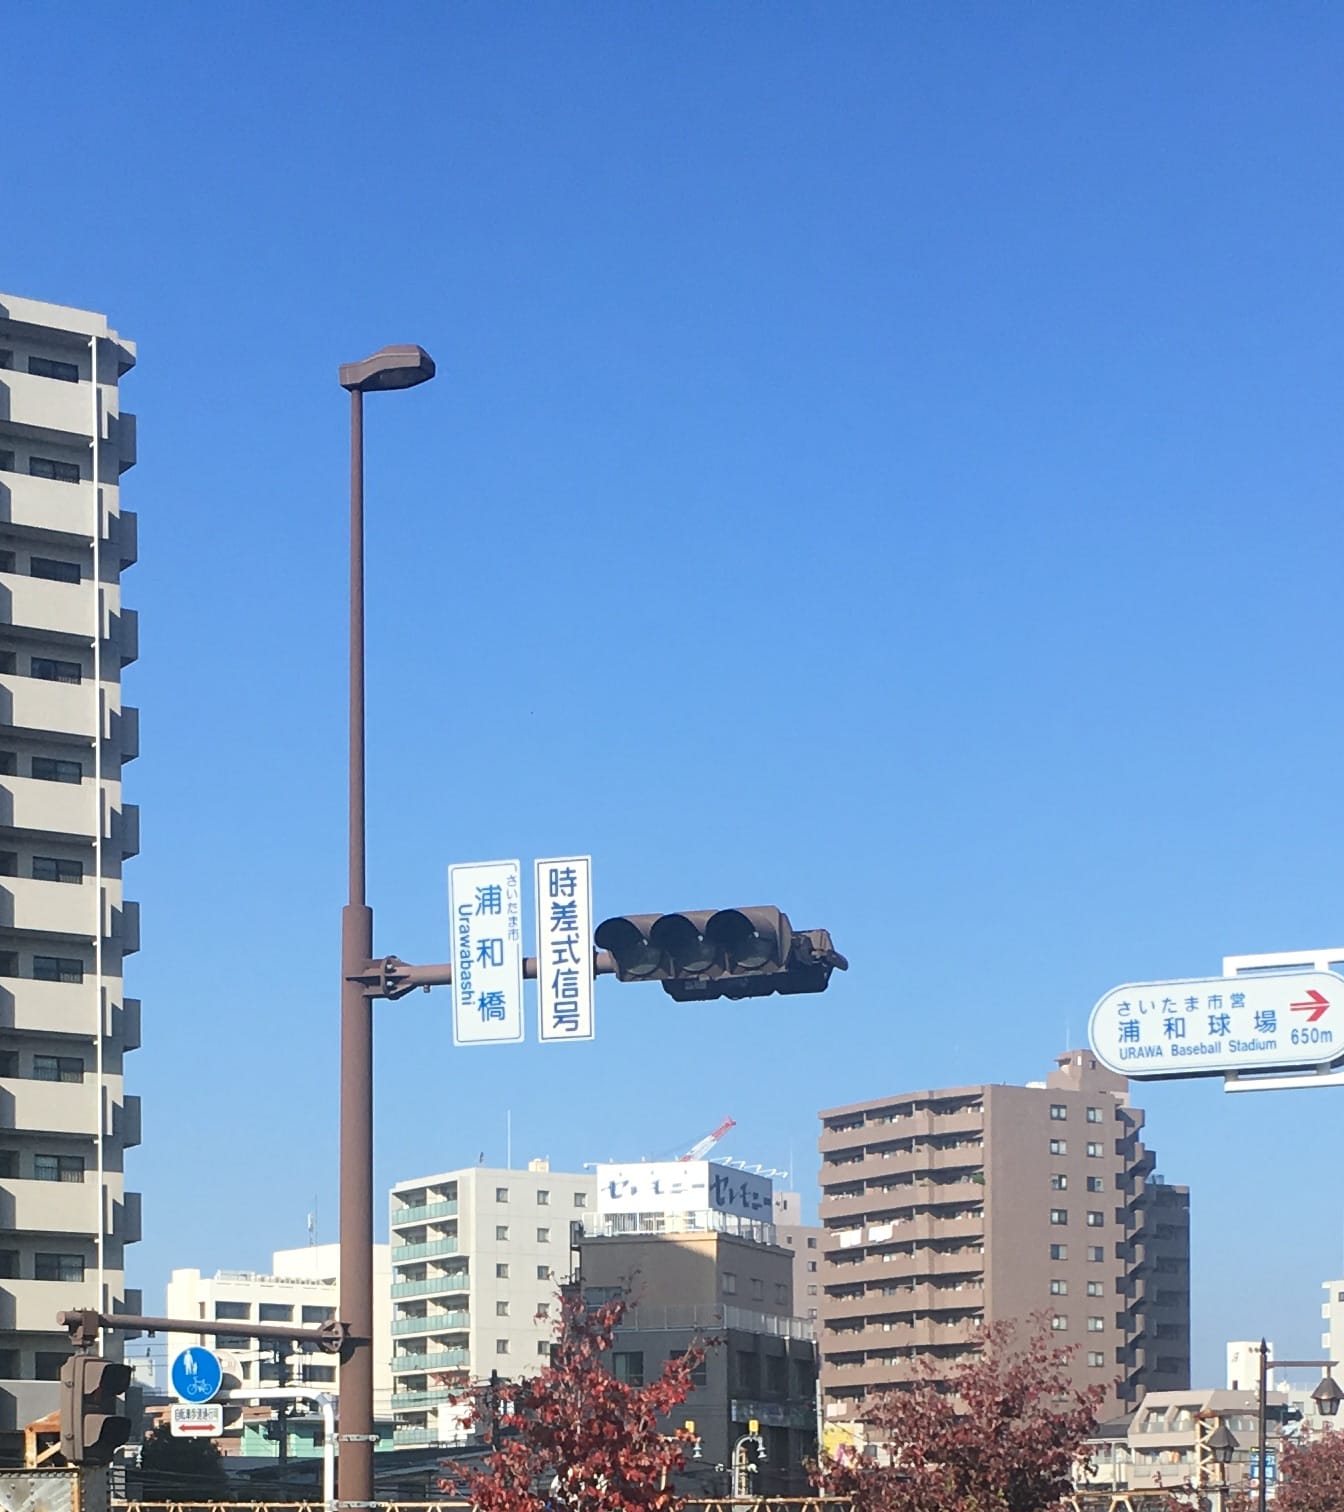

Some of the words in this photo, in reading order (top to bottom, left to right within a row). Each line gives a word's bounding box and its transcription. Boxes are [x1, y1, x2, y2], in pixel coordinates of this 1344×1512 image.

[506, 874, 519, 941] さいたま市
[458, 904, 475, 1006] Urawabashi
[474, 884, 506, 1022] 浦和橋
[549, 867, 580, 1032] 時差式信号
[1116, 992, 1247, 1017] さいたま市営
[1117, 1010, 1278, 1043] 浦和球場
[1290, 1027, 1333, 1045] 650m
[1119, 1044, 1163, 1061] URAWA
[1171, 1041, 1222, 1057] Baseball
[1228, 1038, 1277, 1053] Stadium
[711, 1173, 772, 1211] セレモニー
